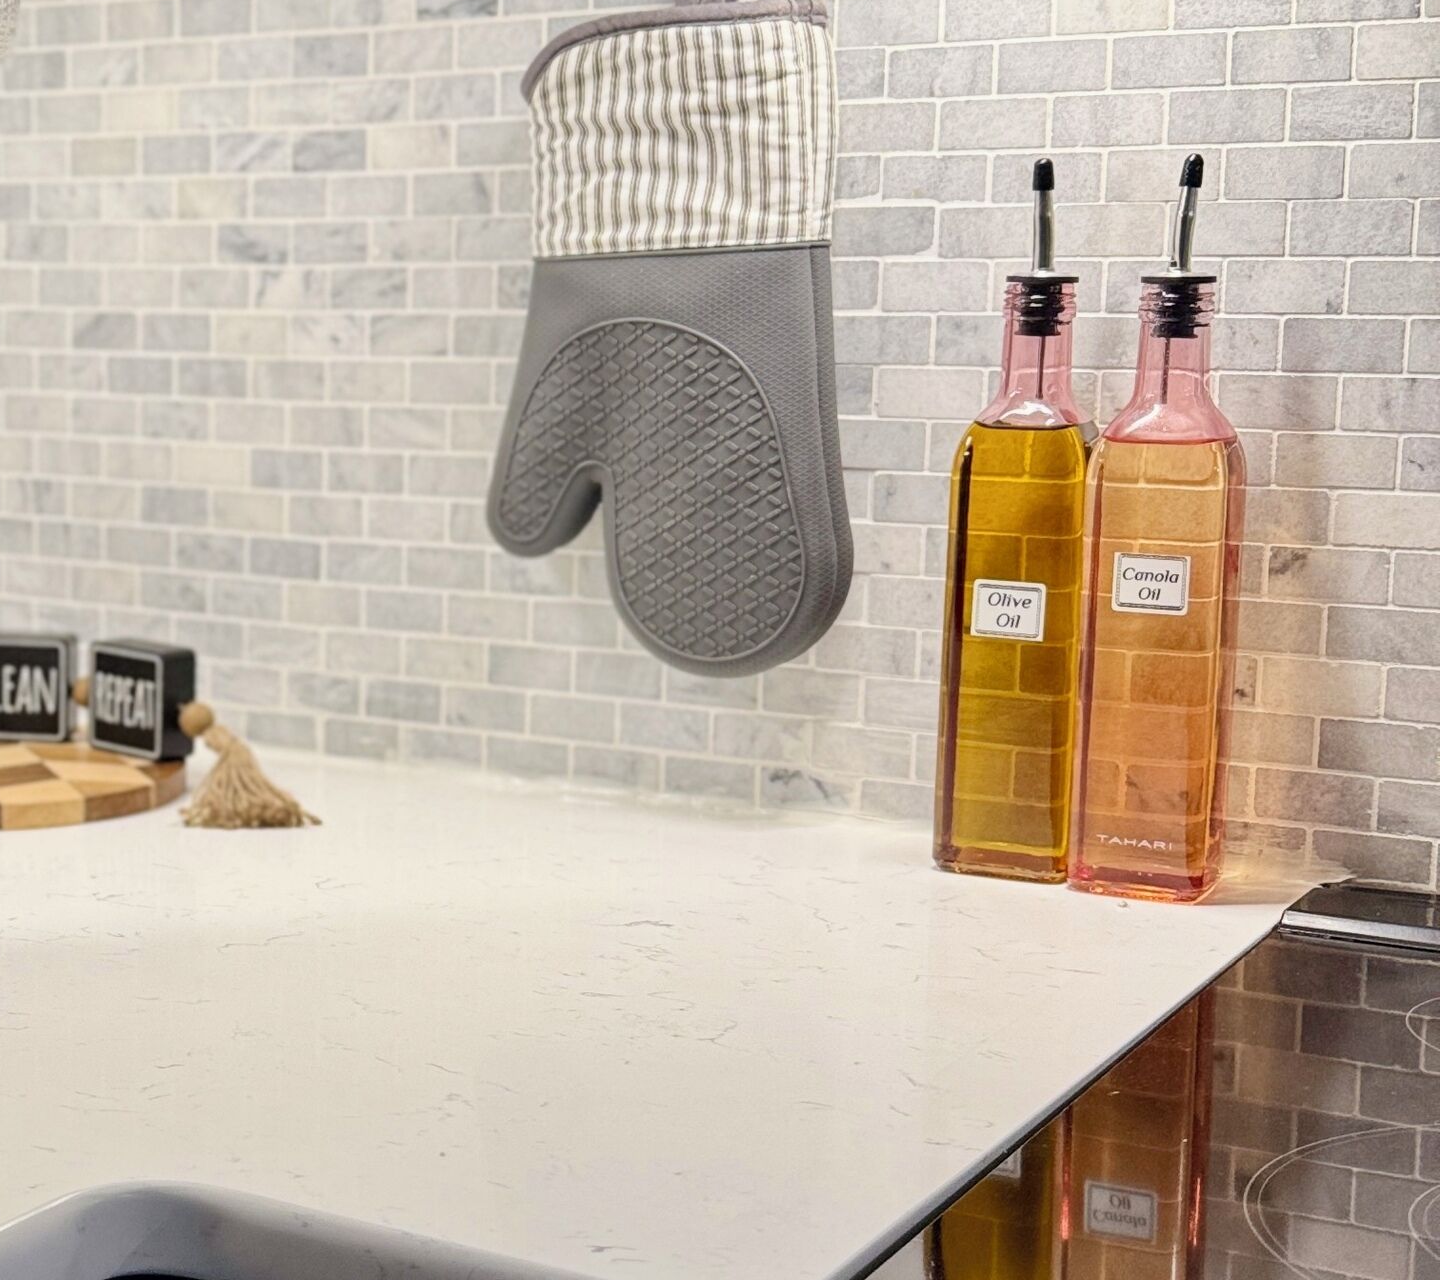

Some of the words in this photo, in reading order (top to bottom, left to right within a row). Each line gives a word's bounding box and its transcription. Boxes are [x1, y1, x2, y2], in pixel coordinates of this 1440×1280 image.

[1121, 566, 1180, 585] Canola
[987, 591, 1033, 610] Olive
[1138, 586, 1161, 602] Oil
[996, 612, 1021, 629] Oil
[95, 671, 156, 731] REPEAT
[1096, 832, 1174, 851] TAHARI
